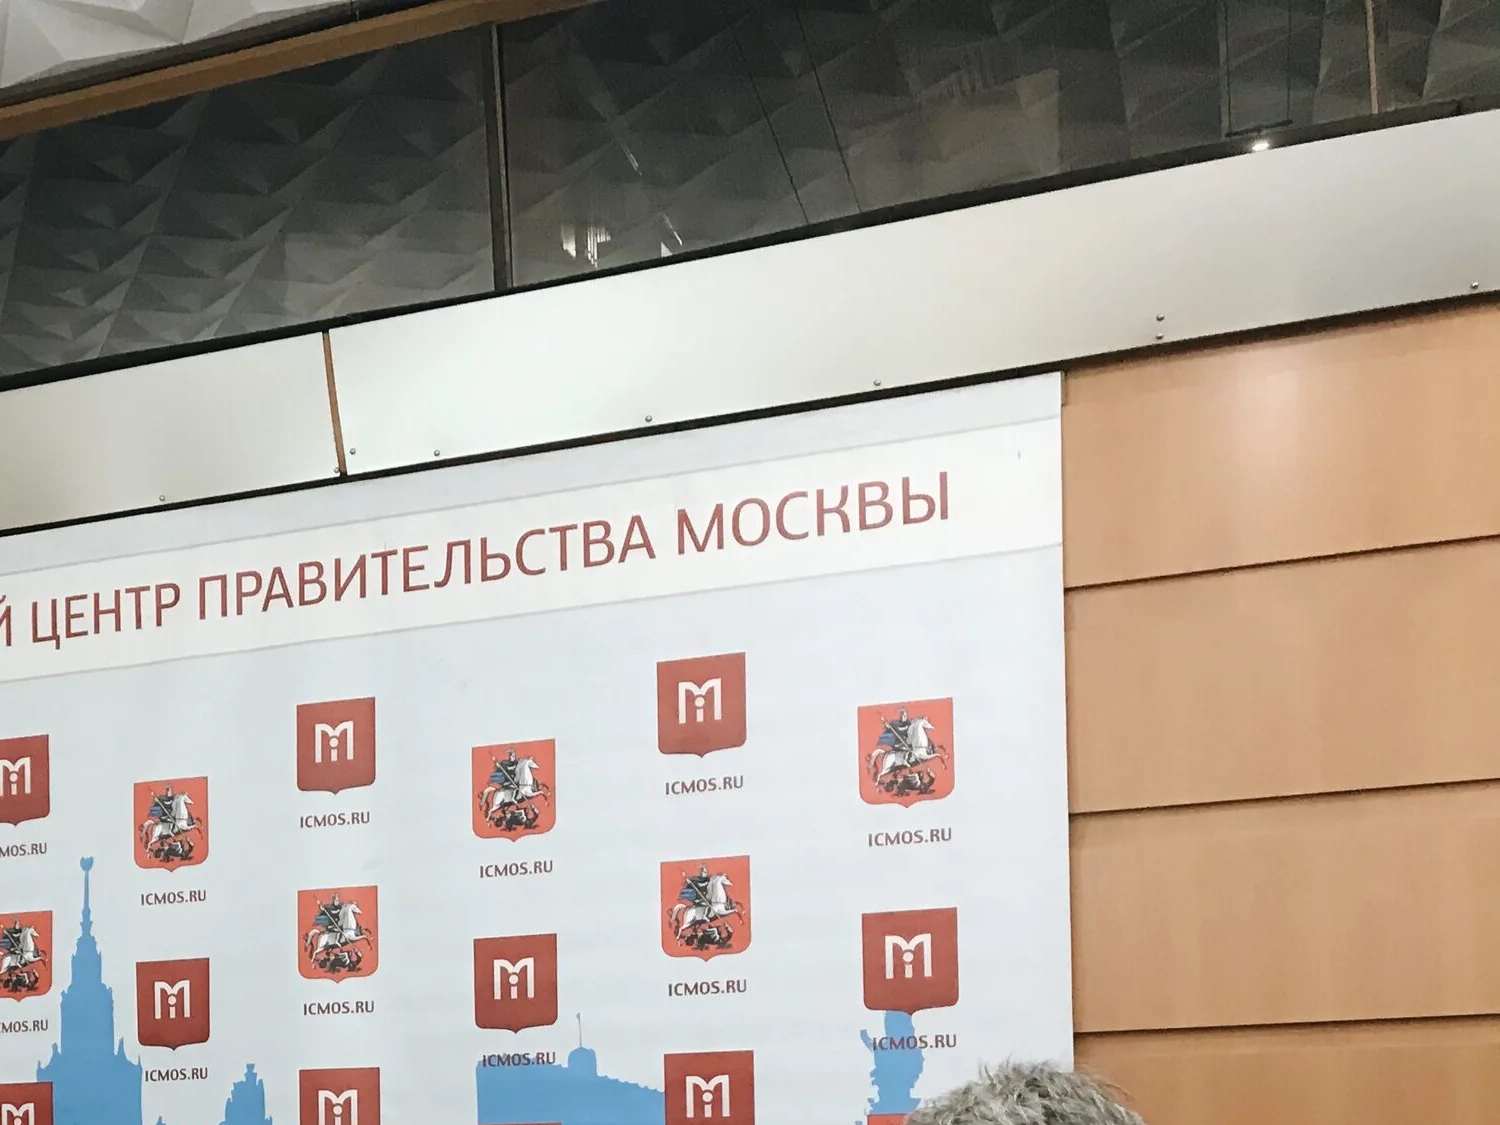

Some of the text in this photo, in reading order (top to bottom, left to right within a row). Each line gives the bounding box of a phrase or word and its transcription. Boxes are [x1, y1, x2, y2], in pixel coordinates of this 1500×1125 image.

[31, 582, 181, 650] ЦЕНТР
[198, 514, 656, 620] ПРАВИТЕЛЬСТВА
[677, 471, 949, 555] МОСКВЫ
[666, 776, 743, 795] ICMOS.RU
[301, 812, 369, 828] ICMOS.RU
[869, 828, 951, 846] ICMOS.RU
[480, 861, 552, 877] ICMOS.RU
[141, 890, 206, 905] ICMOS.RU
[669, 980, 746, 996] ICMOS.RU
[304, 1001, 374, 1015] ICMOS.RU
[872, 1034, 957, 1051] ICMOS.RU
[483, 1052, 555, 1067] ICMOS.RU
[145, 1067, 208, 1082] ICMOS.RU
